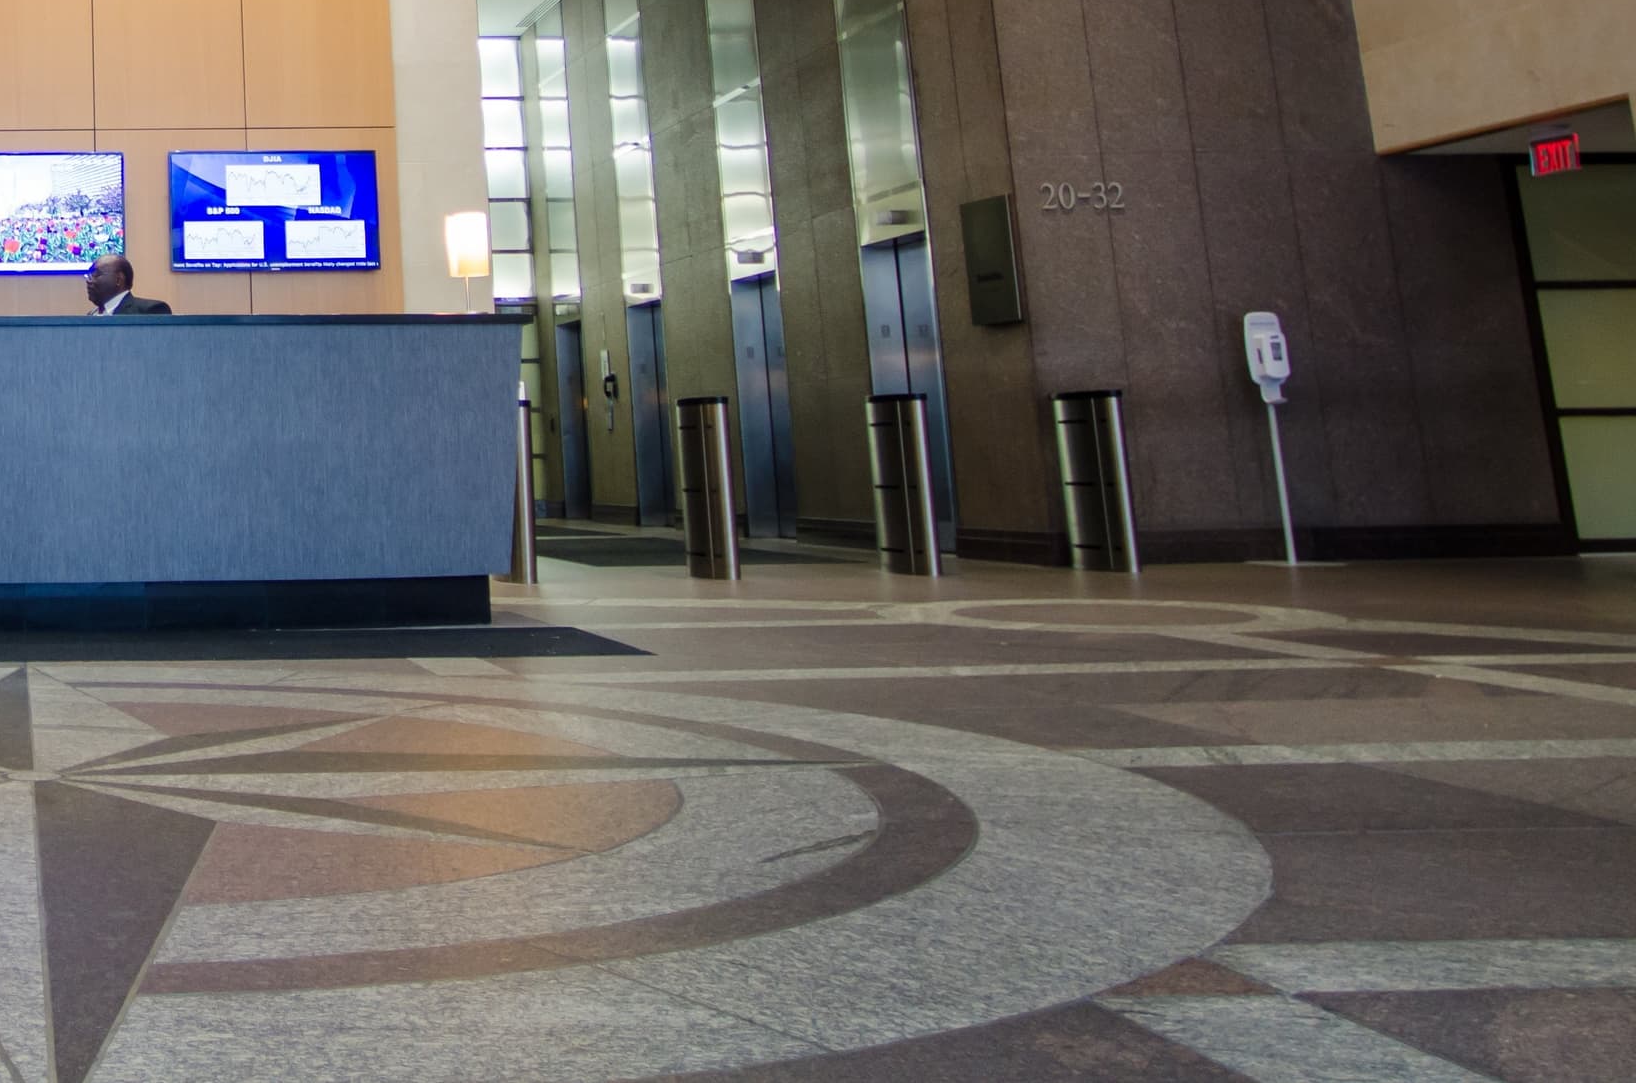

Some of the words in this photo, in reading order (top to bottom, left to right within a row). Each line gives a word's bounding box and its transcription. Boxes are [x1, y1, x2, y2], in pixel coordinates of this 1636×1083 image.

[262, 155, 282, 163] DJIA
[1536, 139, 1571, 173] EXIT
[1040, 182, 1125, 210] 20-32
[206, 207, 224, 215] S&P
[307, 206, 342, 214] NASDAQ
